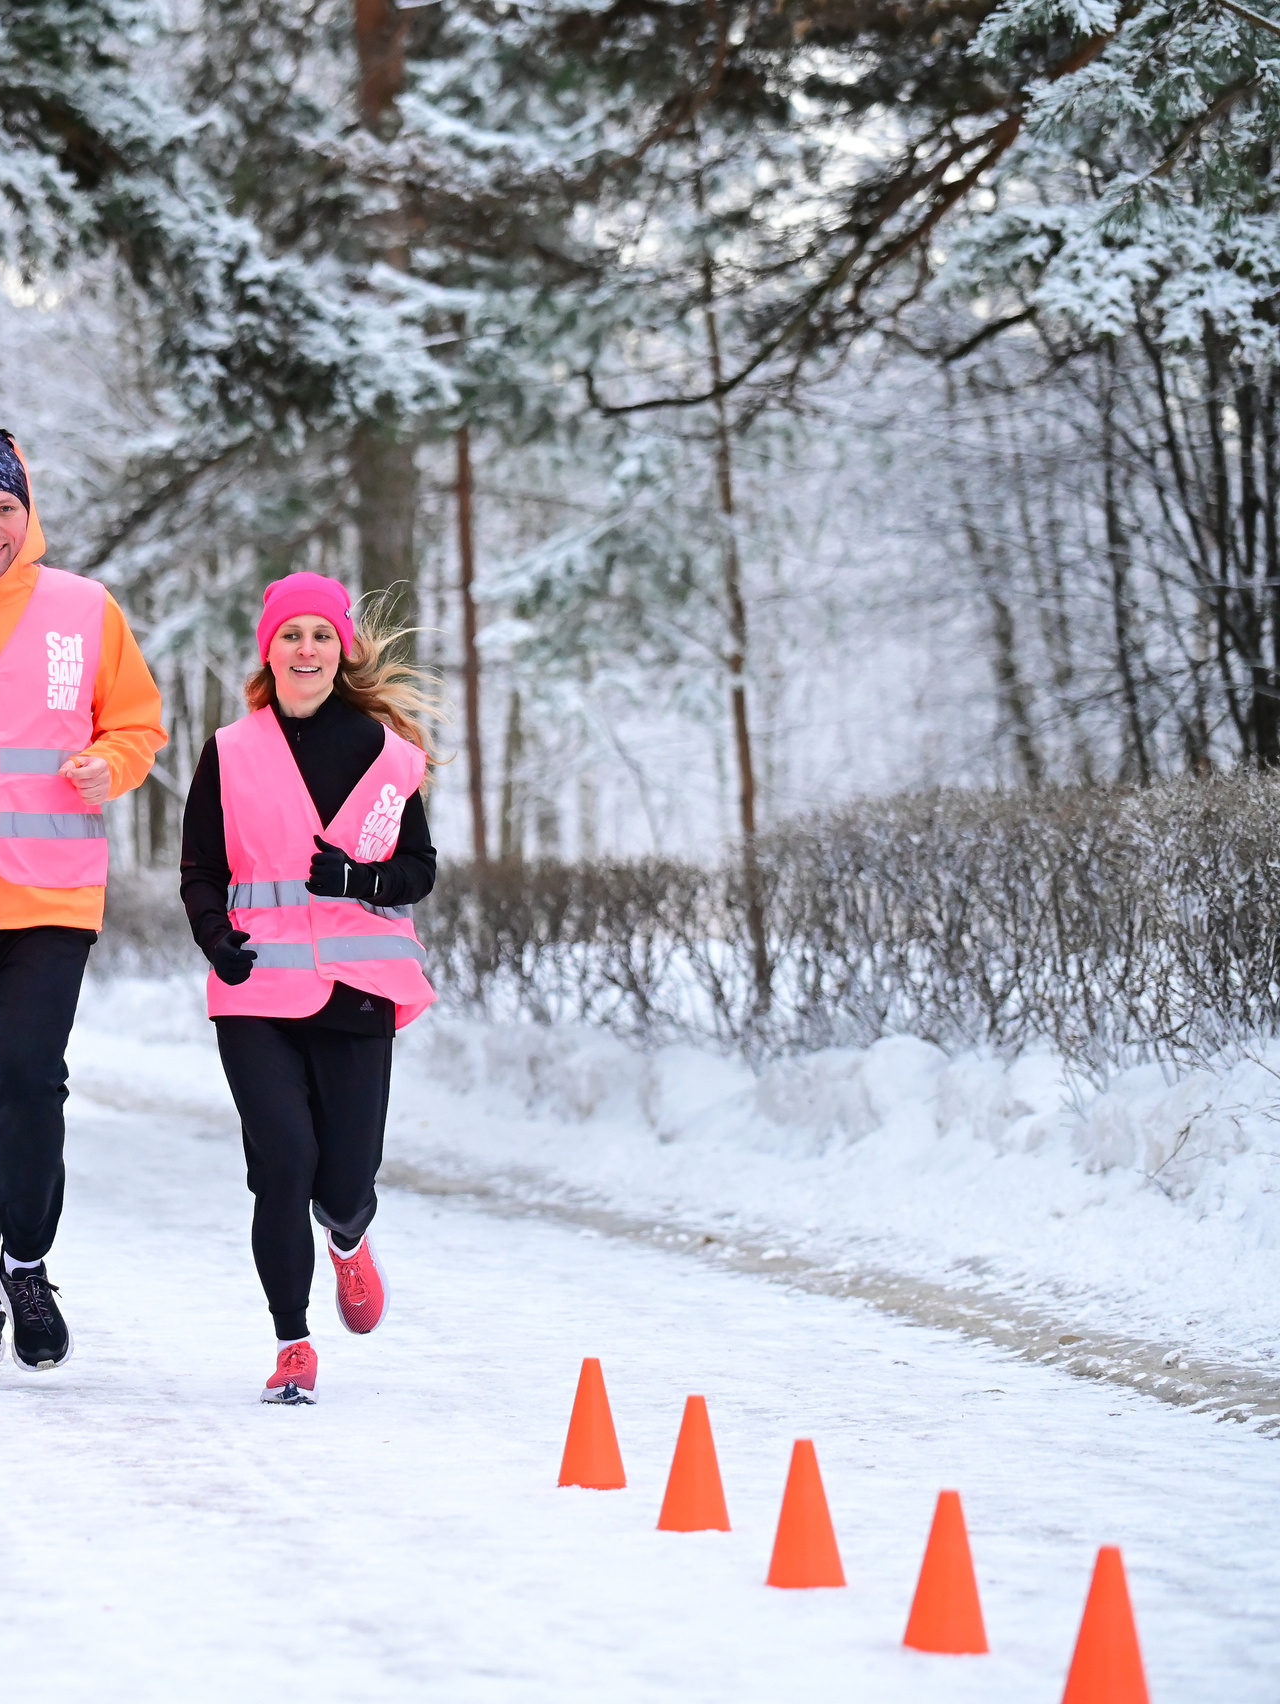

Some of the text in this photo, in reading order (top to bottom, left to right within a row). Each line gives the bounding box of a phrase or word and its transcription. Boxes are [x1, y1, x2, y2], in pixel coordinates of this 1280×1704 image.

[45, 631, 84, 663] Sat
[47, 660, 83, 687] 9AM
[46, 685, 79, 711] 5KM
[373, 783, 407, 823] Sa
